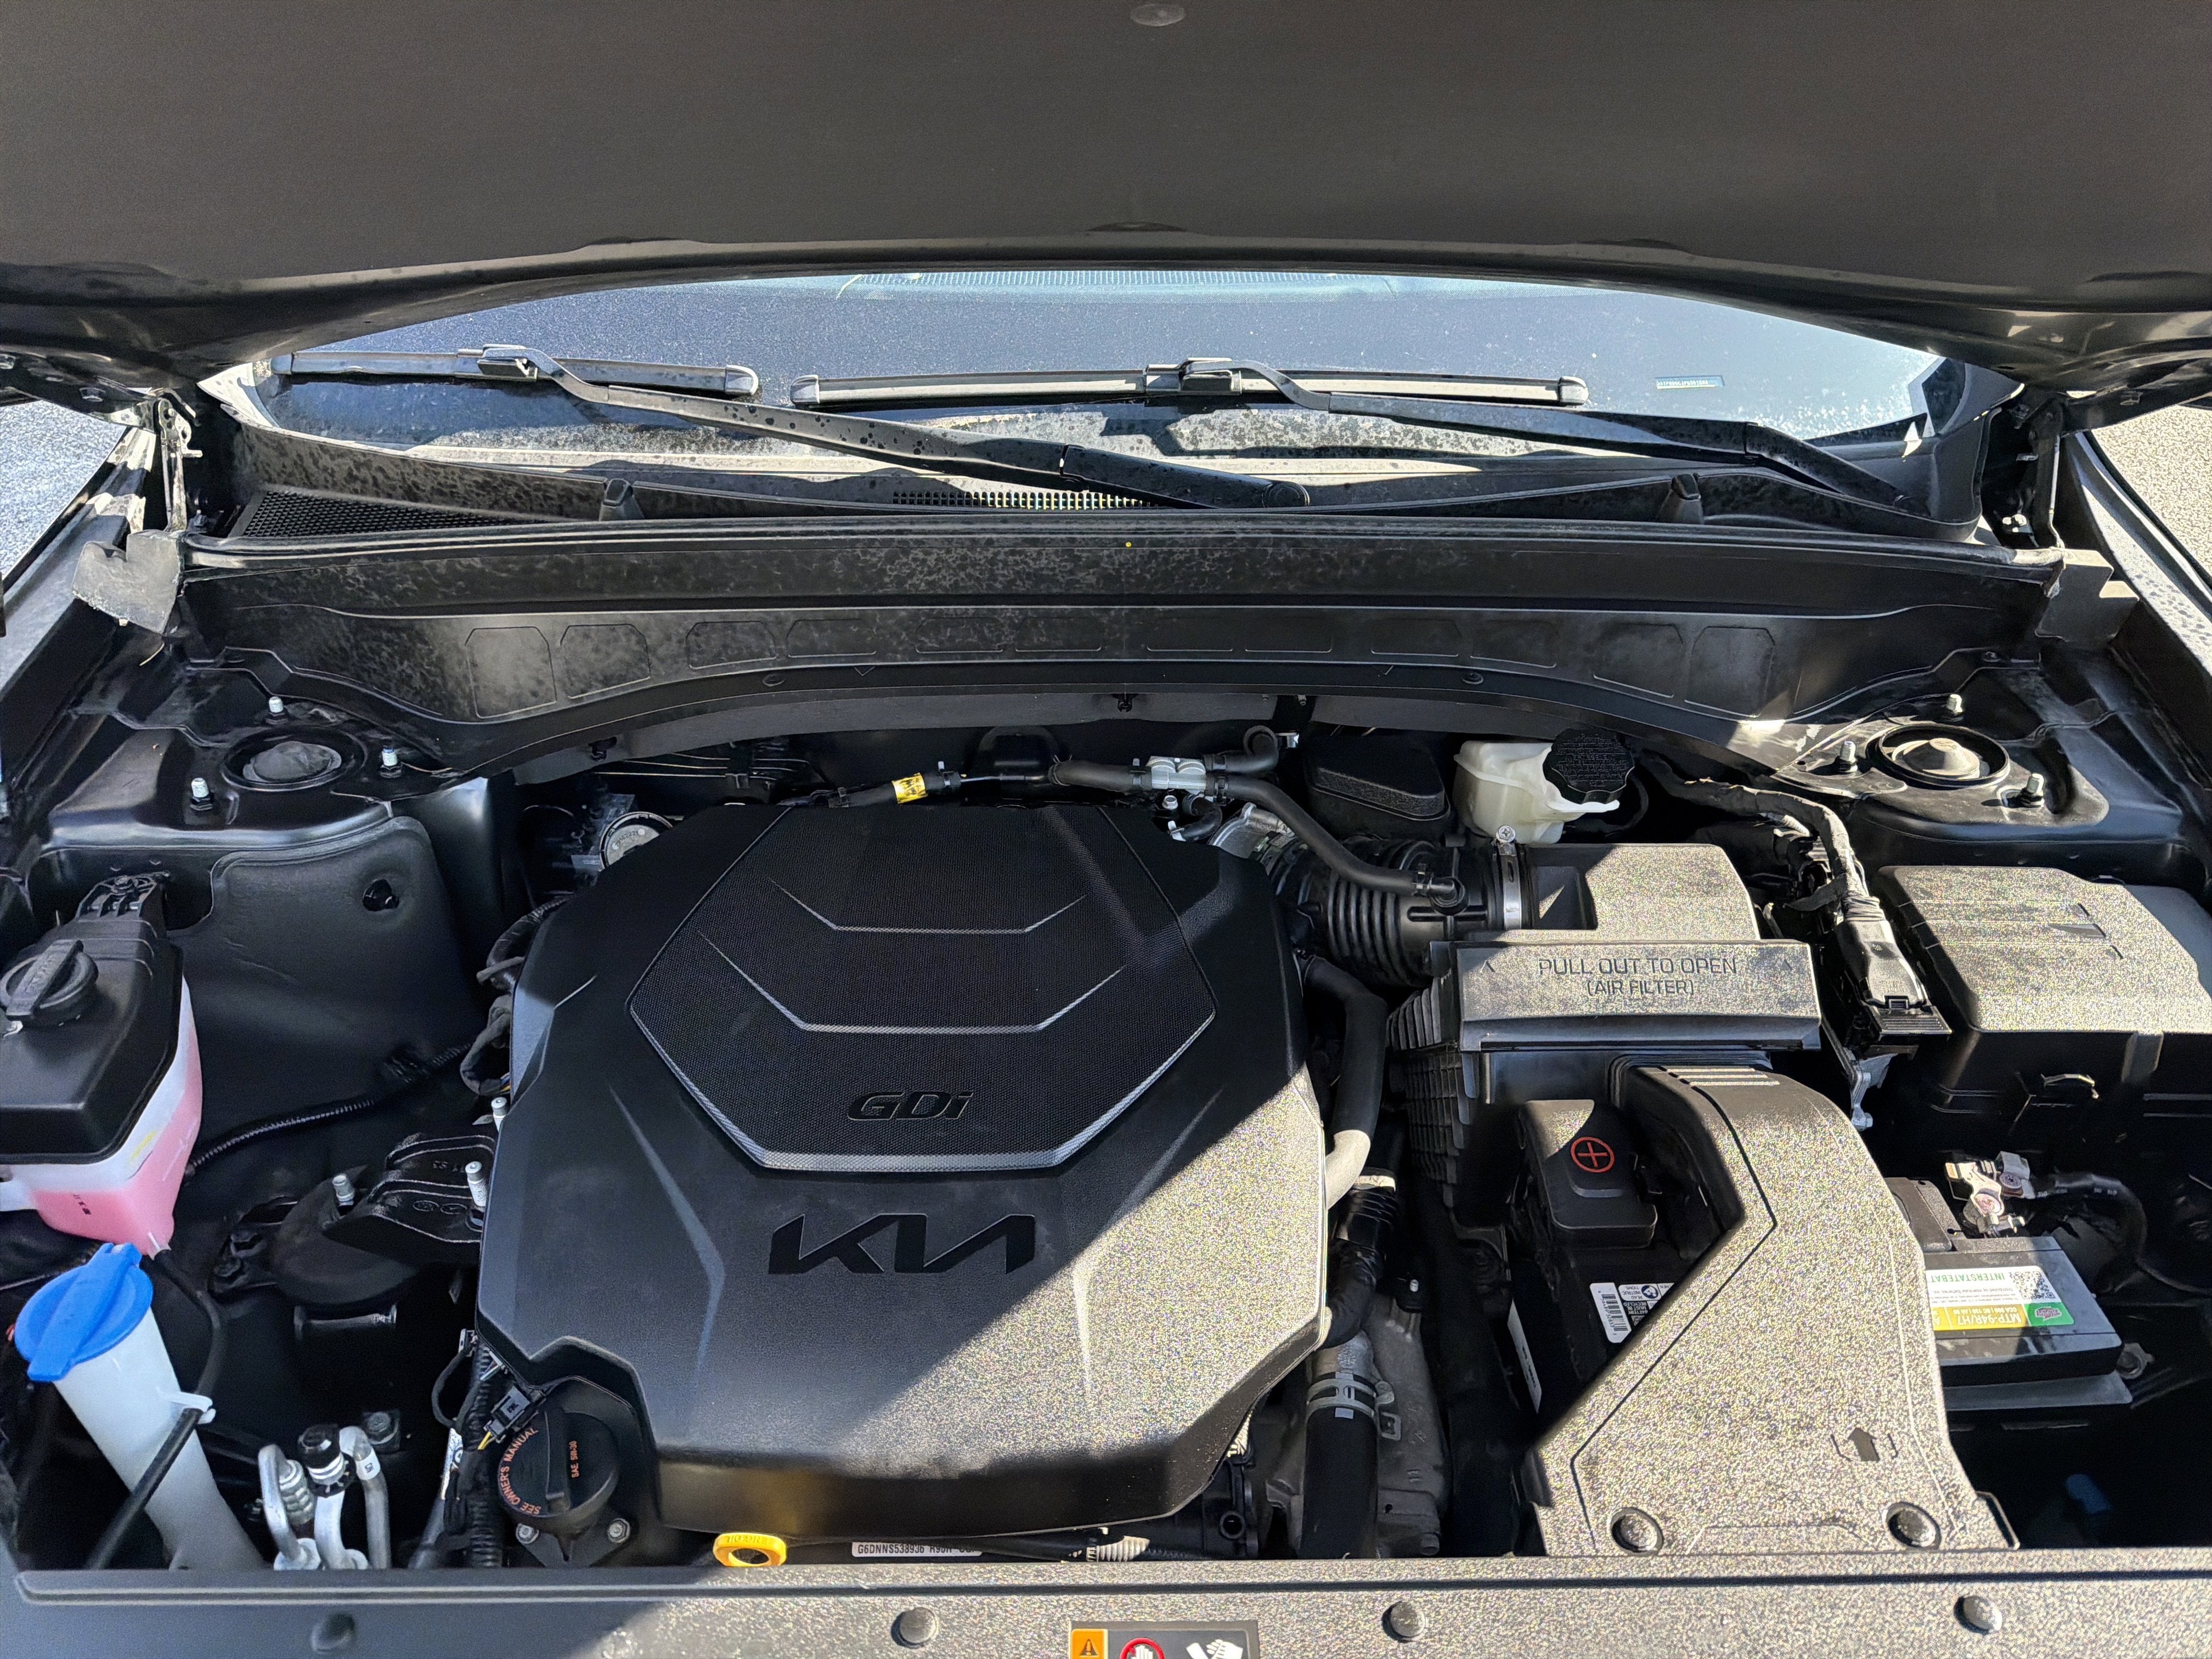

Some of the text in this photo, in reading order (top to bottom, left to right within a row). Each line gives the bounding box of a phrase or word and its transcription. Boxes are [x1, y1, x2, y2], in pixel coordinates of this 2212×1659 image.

[1538, 957, 1737, 975] PULL OUT TO OPEN
[1587, 979, 1695, 996] (AIR FILTER)
[768, 1212, 1036, 1276] KIA
[1929, 1273, 2006, 1283] INTERSTATEBAT
[1957, 1313, 2023, 1326] MTP-94R/H7
[503, 1427, 539, 1462] MANUAL
[568, 1440, 579, 1479] SAE 5W-30
[499, 1465, 521, 1505] OWNER'S
[520, 1502, 542, 1515] SEE
